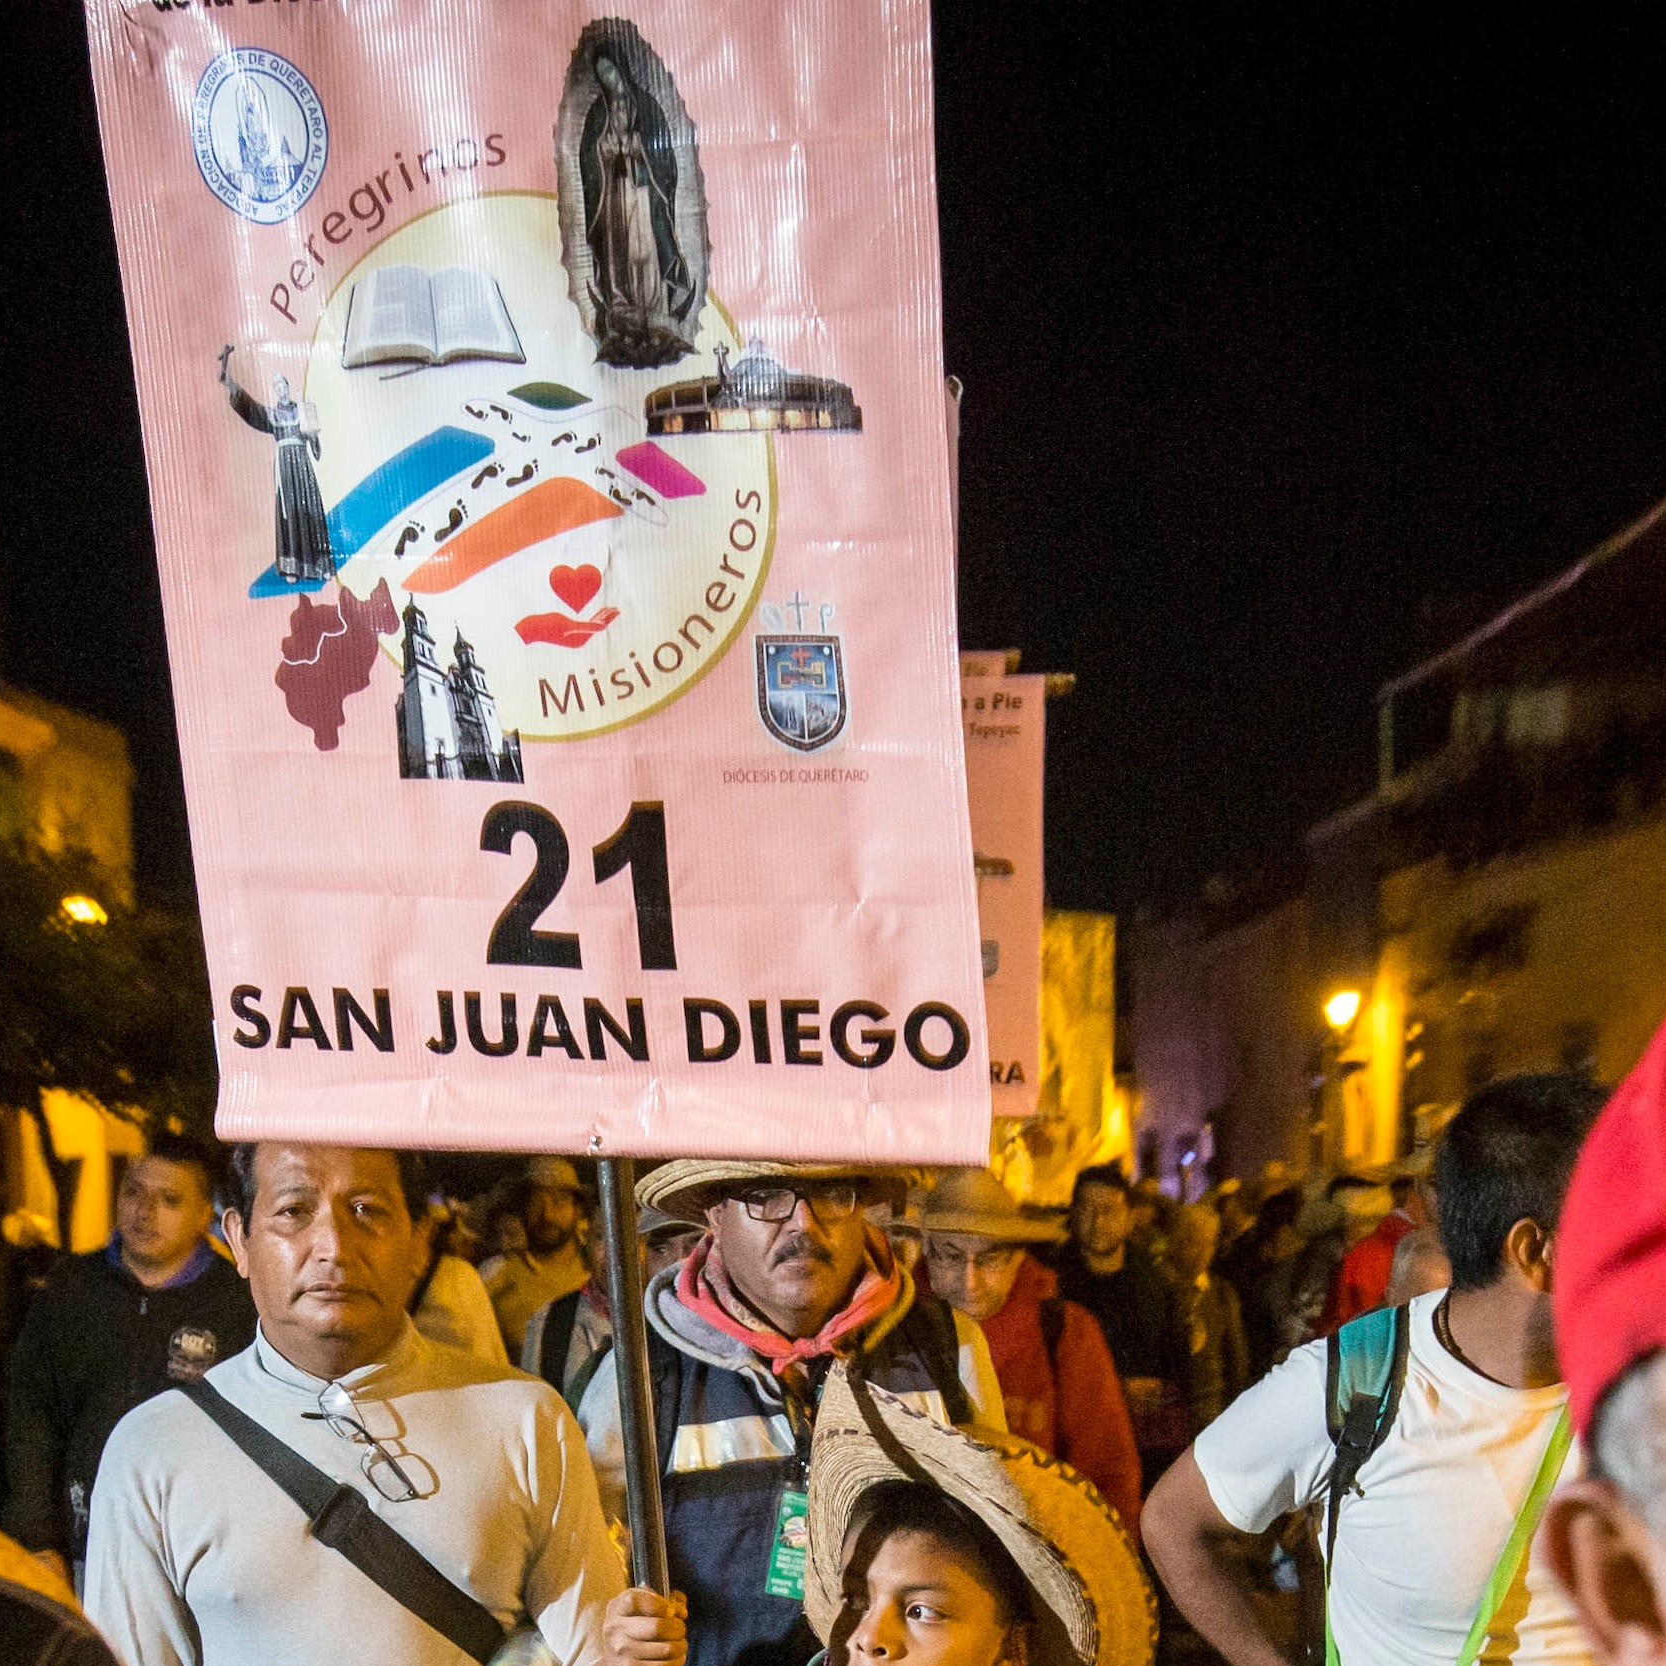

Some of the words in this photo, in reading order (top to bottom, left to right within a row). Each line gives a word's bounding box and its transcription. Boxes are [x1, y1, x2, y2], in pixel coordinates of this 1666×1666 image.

[248, 52, 266, 67] DE
[269, 58, 323, 140] QUERETARO
[310, 144, 323, 163] AL
[269, 133, 507, 325] Peregrinos
[538, 488, 762, 718] Misioneros
[992, 691, 1023, 711] Pie
[779, 769, 795, 783] DE
[478, 799, 678, 972] 21
[230, 983, 395, 1054] SAN
[424, 986, 649, 1064] JUAN
[685, 997, 970, 1073] DIEGO
